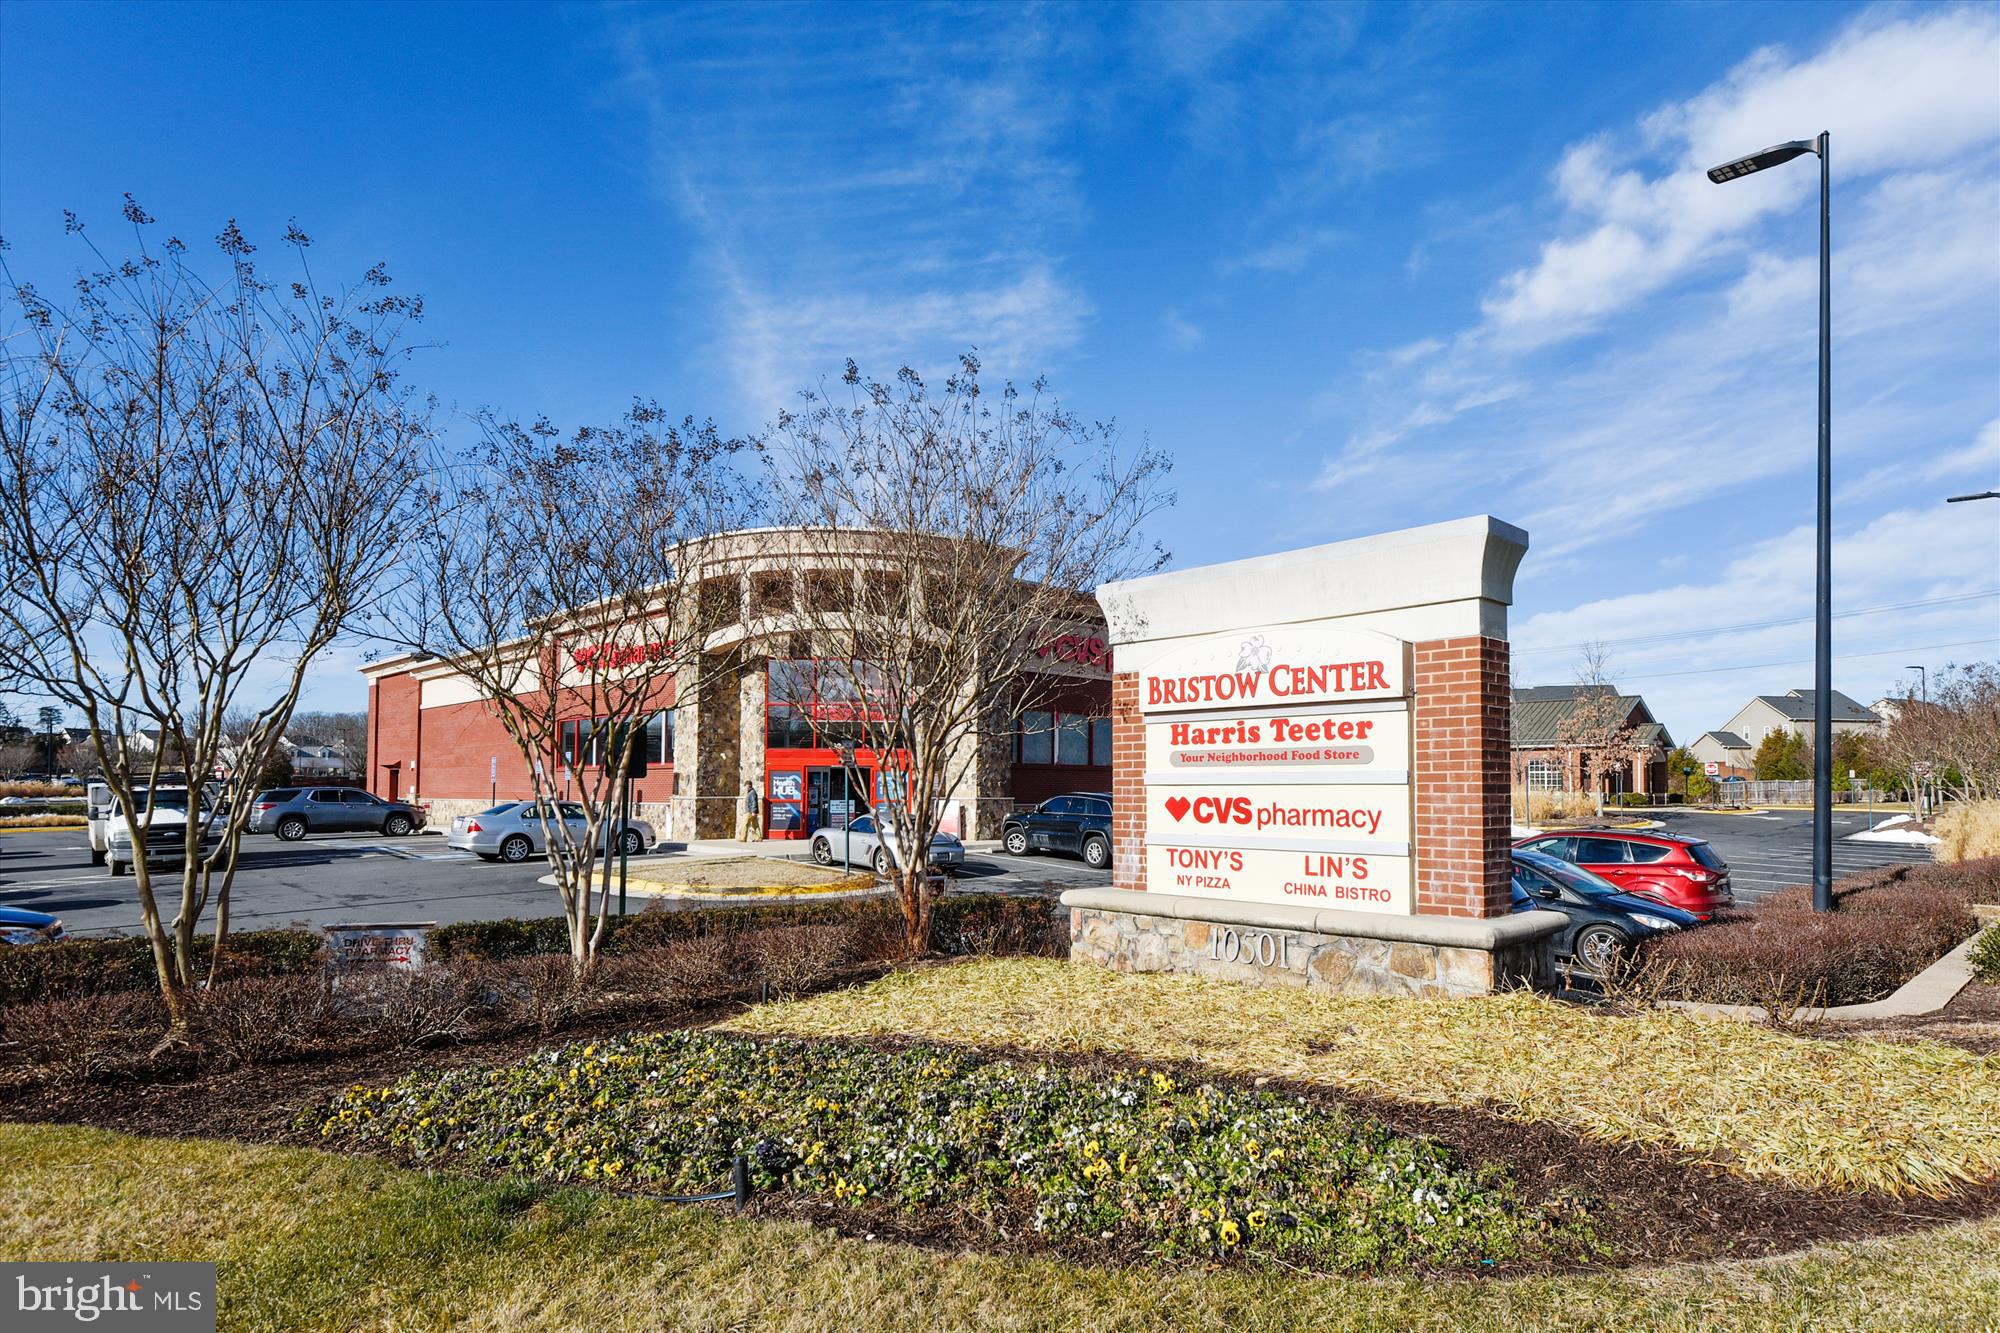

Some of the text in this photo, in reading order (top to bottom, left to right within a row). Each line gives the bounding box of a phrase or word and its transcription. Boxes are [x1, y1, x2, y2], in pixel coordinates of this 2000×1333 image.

[1147, 660, 1391, 705] BRISTOW CENTER
[1169, 717, 1374, 747] Harris Teeter
[1179, 748, 1360, 764] Your Neighborhood Food Store
[1192, 795, 1383, 836] CVS pharmacy
[1166, 847, 1245, 873] TONY'S
[1304, 854, 1369, 881] LIN'S
[1176, 874, 1231, 890] NY PIZZA
[1283, 881, 1392, 903] CHINA BISTRO
[1208, 927, 1290, 970] 10501
